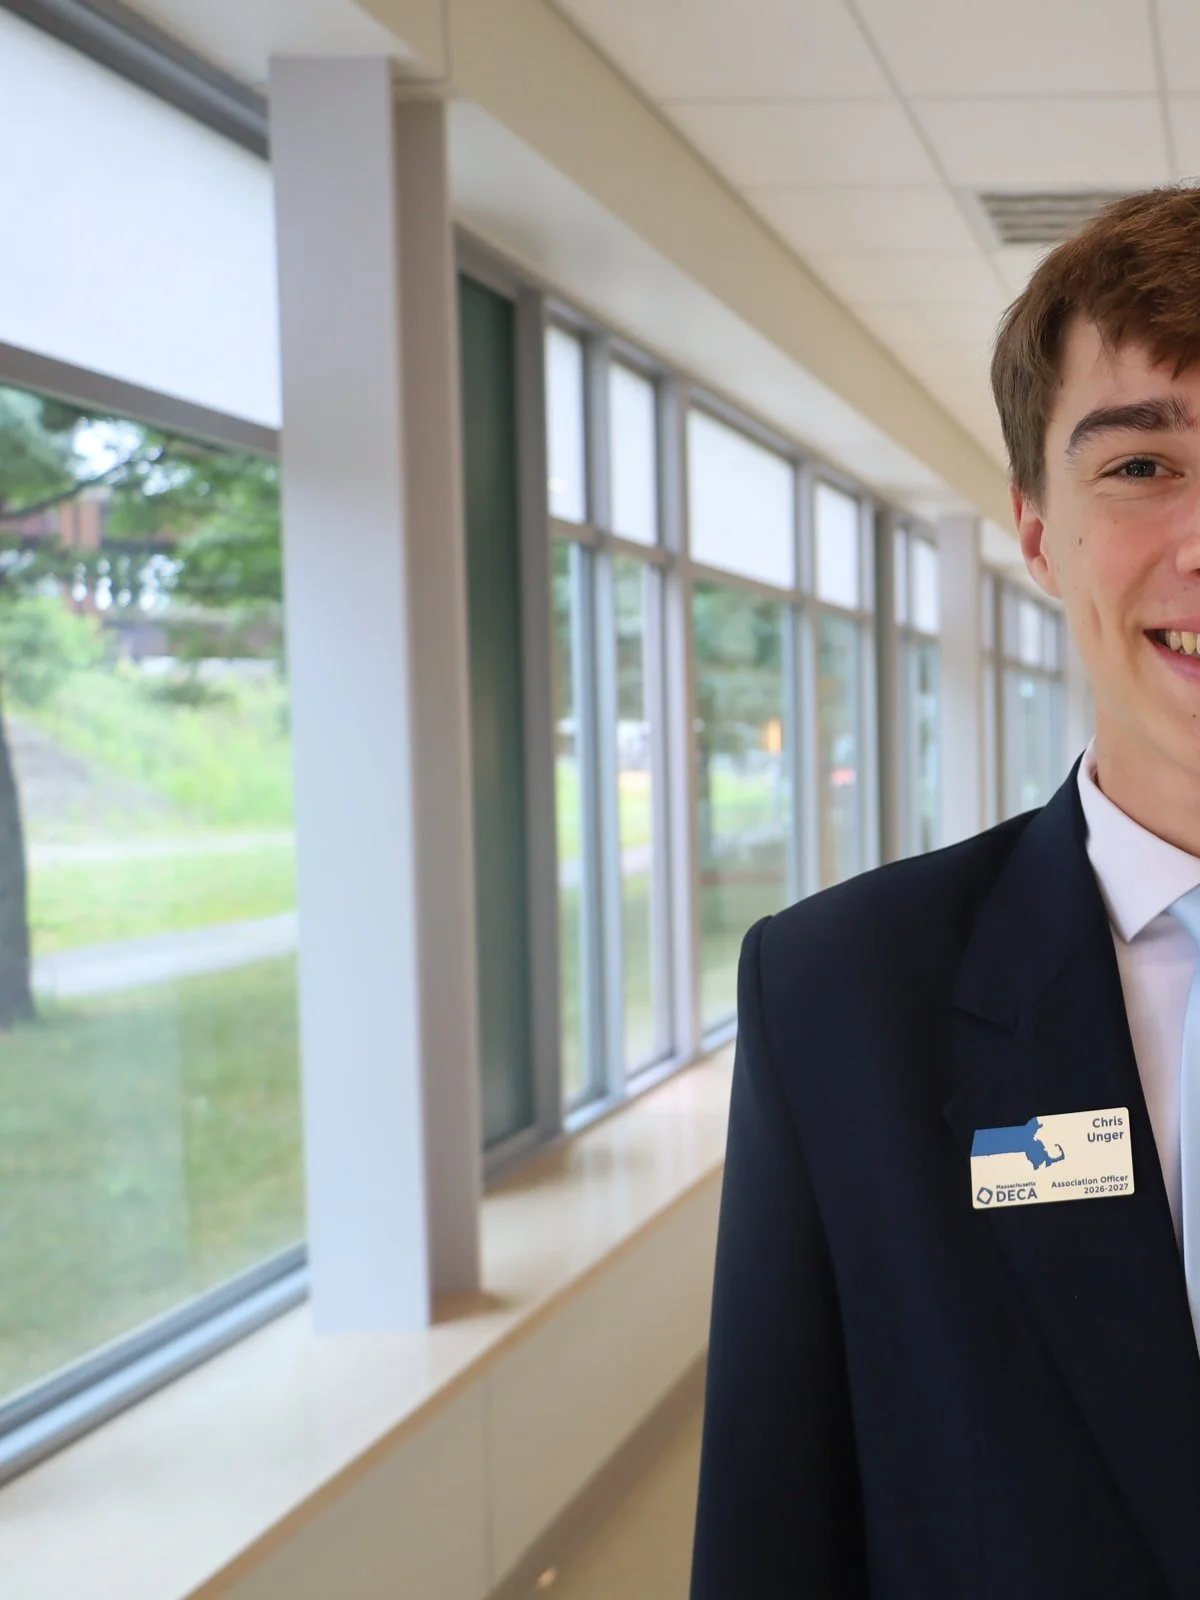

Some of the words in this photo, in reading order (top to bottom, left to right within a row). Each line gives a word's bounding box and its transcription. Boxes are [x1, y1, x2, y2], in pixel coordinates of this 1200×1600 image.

[1092, 1116, 1123, 1128] Chris
[1087, 1131, 1124, 1143] Unger
[1051, 1178, 1098, 1189] Association
[1100, 1174, 1129, 1183] Officer
[1084, 1183, 1129, 1194] 2026-2027
[996, 1188, 1038, 1203] DECA
